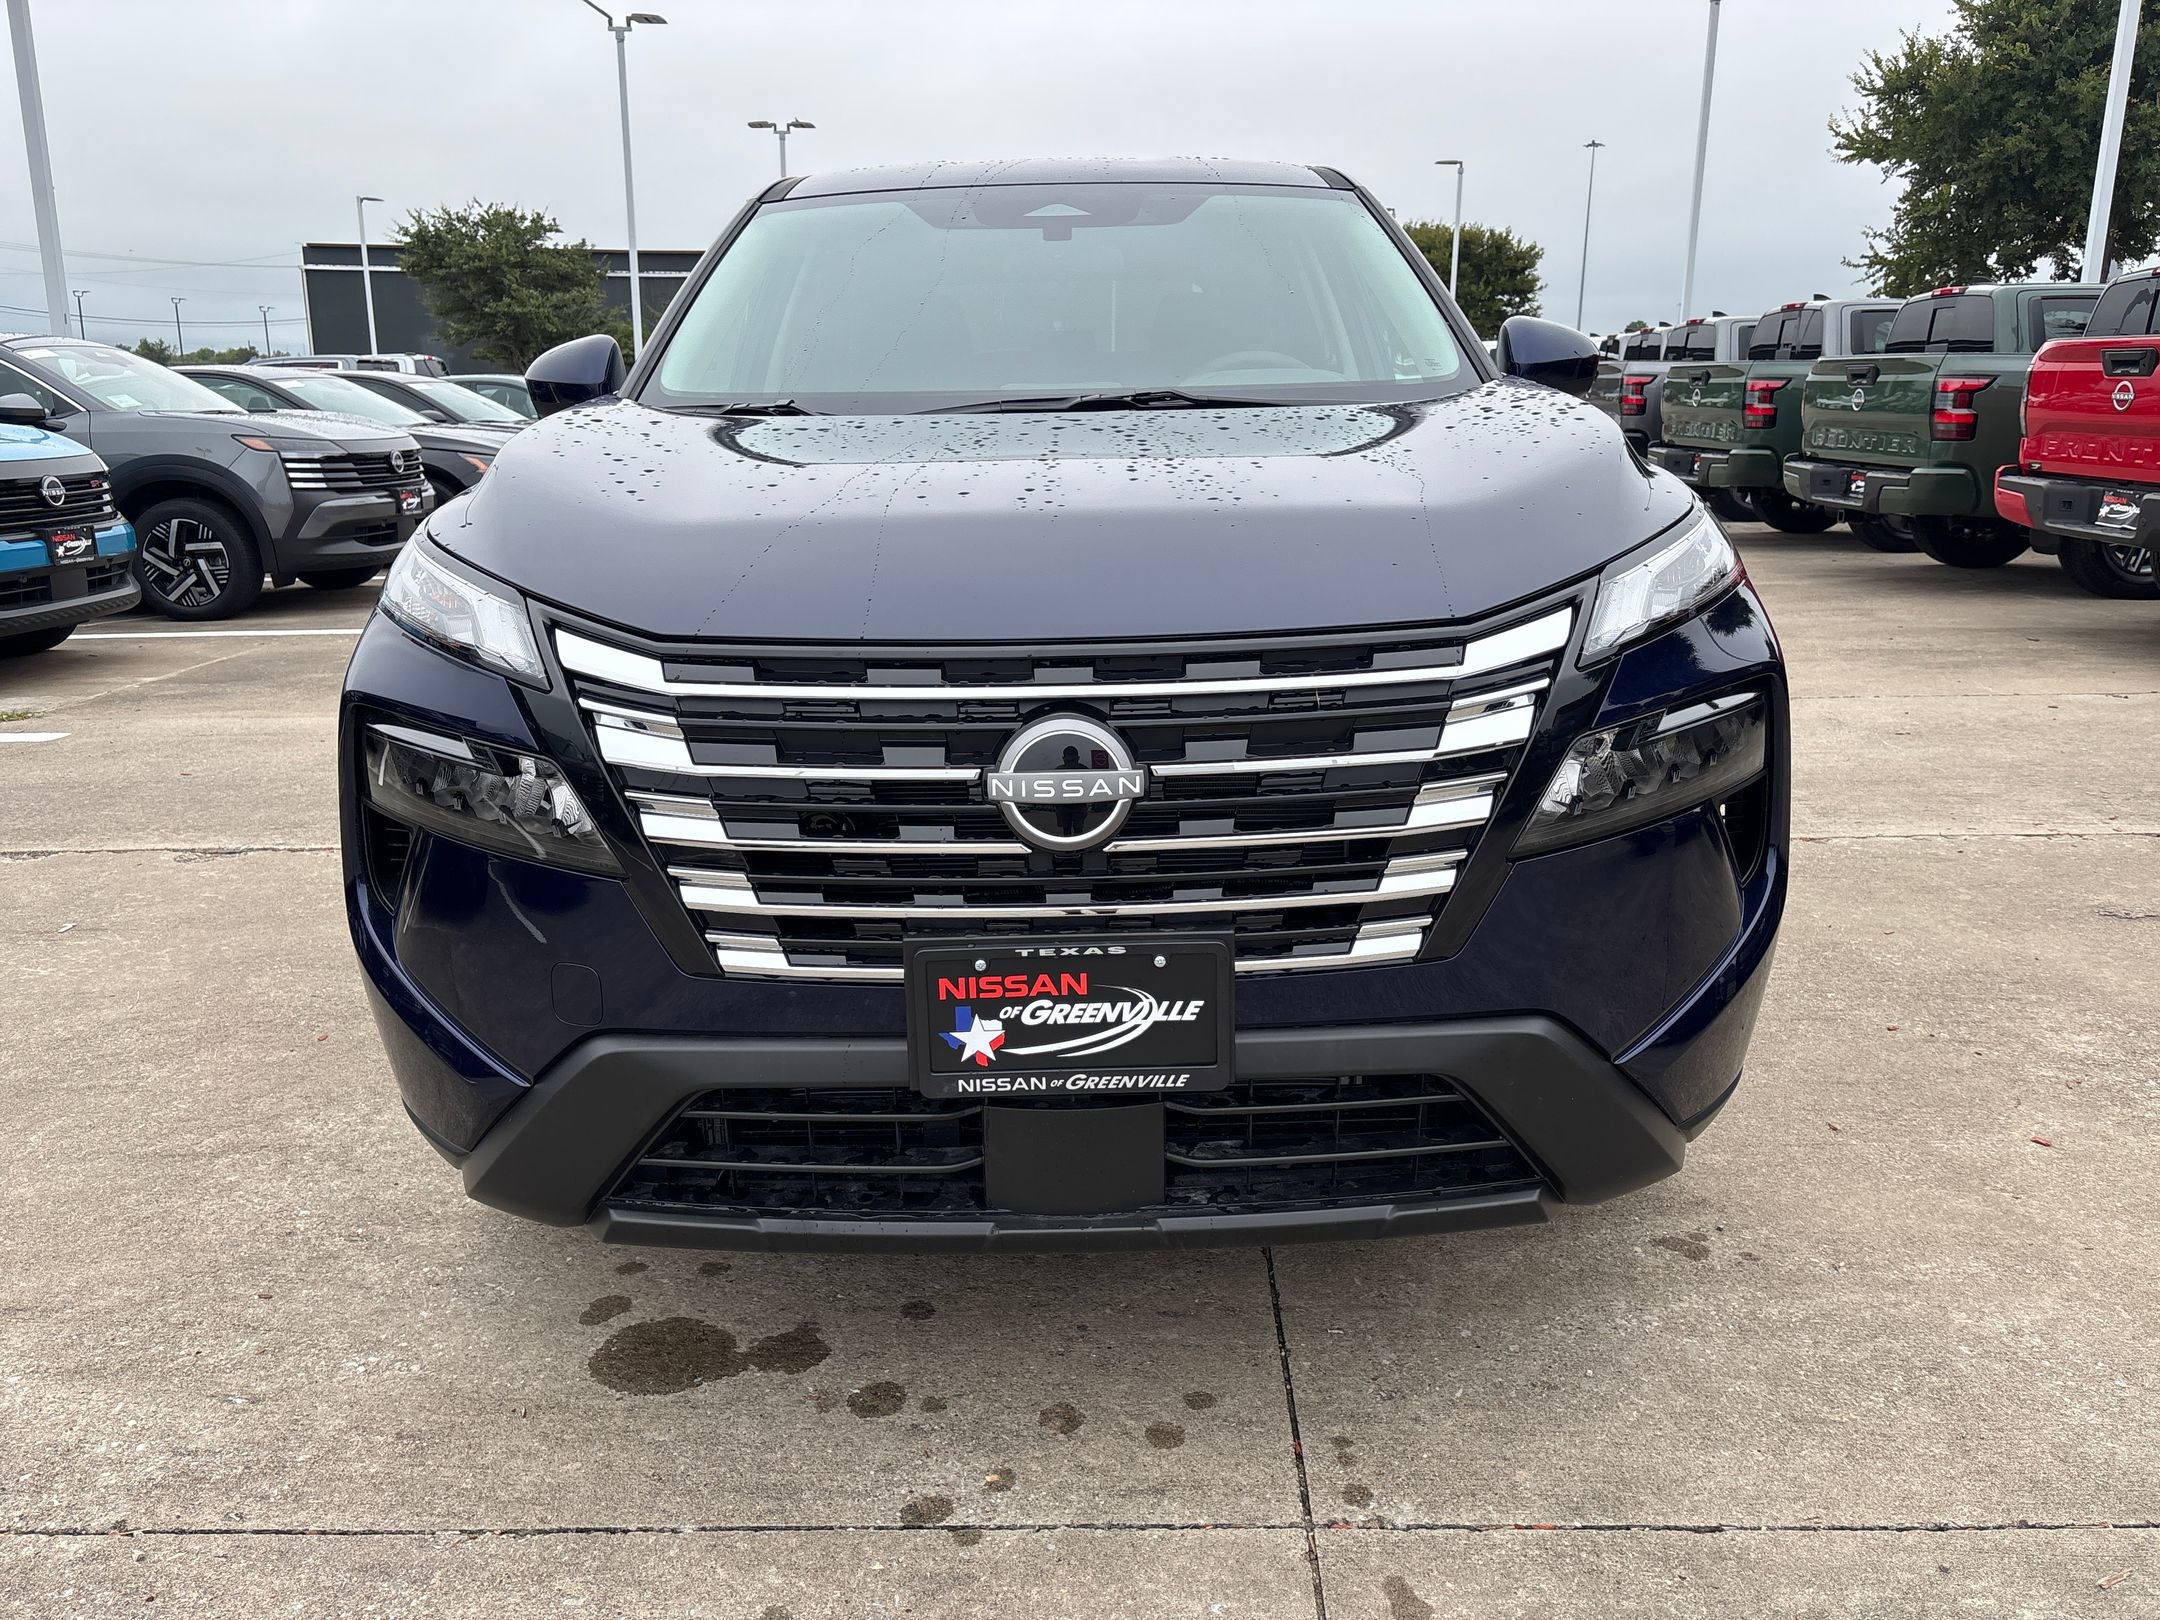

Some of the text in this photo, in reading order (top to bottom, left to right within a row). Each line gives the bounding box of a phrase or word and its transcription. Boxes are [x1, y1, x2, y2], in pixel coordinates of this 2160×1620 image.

[991, 775, 1140, 798] NISSAN
[1015, 946, 1127, 957] TEXAS
[938, 972, 1088, 1001] NISSAN
[1000, 999, 1204, 1025] OF GREENVILLE
[958, 1074, 1190, 1092] NISSAN OF GREENVILLE
